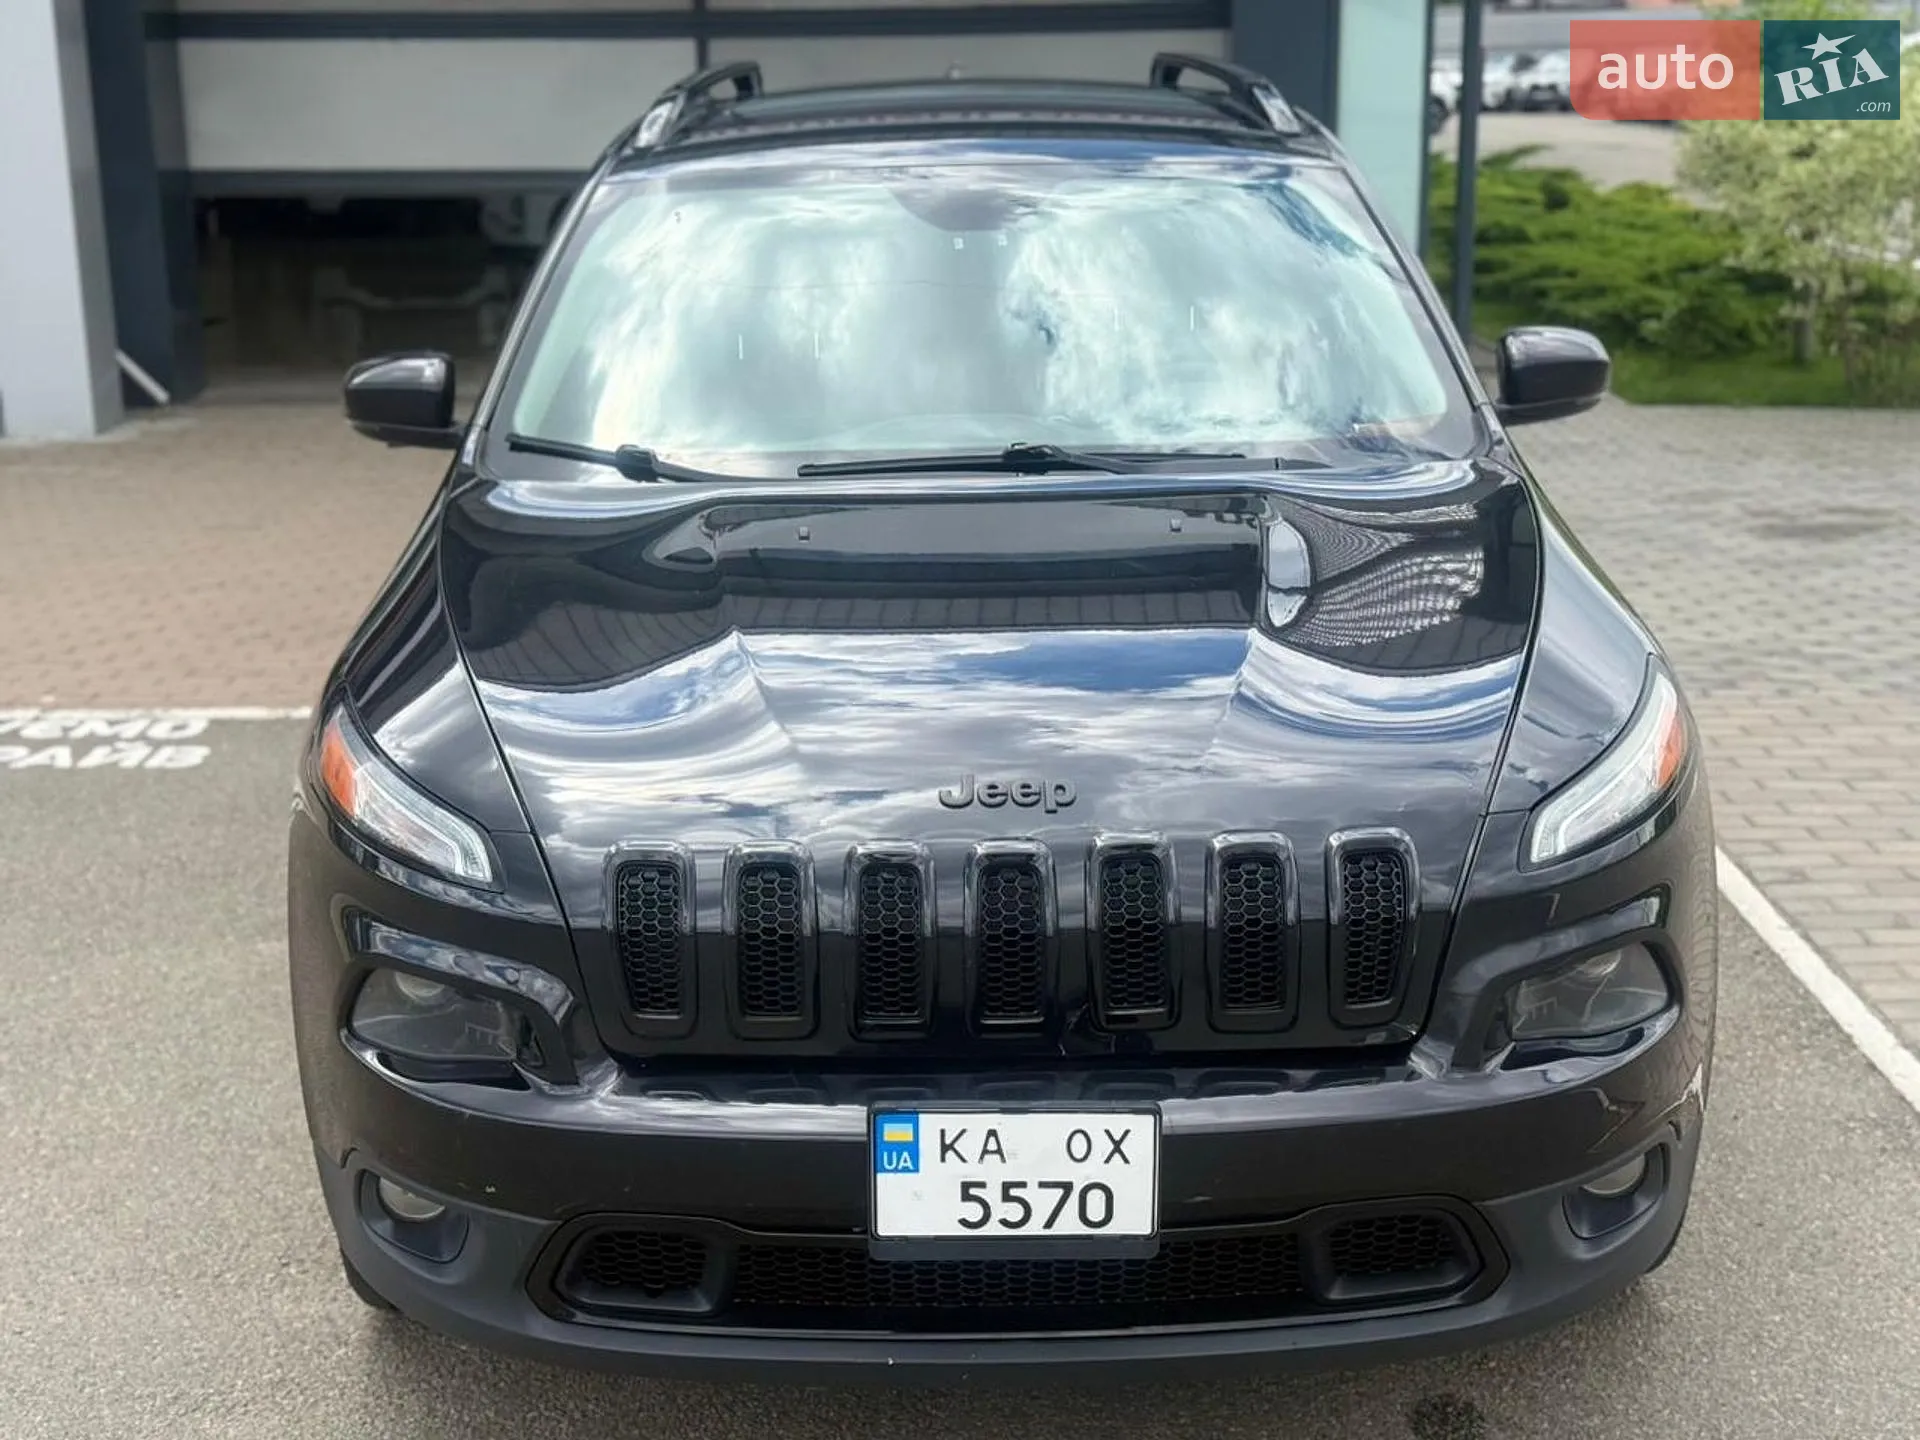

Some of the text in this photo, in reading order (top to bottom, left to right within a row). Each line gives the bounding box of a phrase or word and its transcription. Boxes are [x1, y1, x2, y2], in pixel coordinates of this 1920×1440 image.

[939, 774, 1076, 814] Jeep
[883, 1151, 914, 1170] UA
[939, 1128, 1131, 1165] KA OX
[957, 1181, 1115, 1230] 5570
